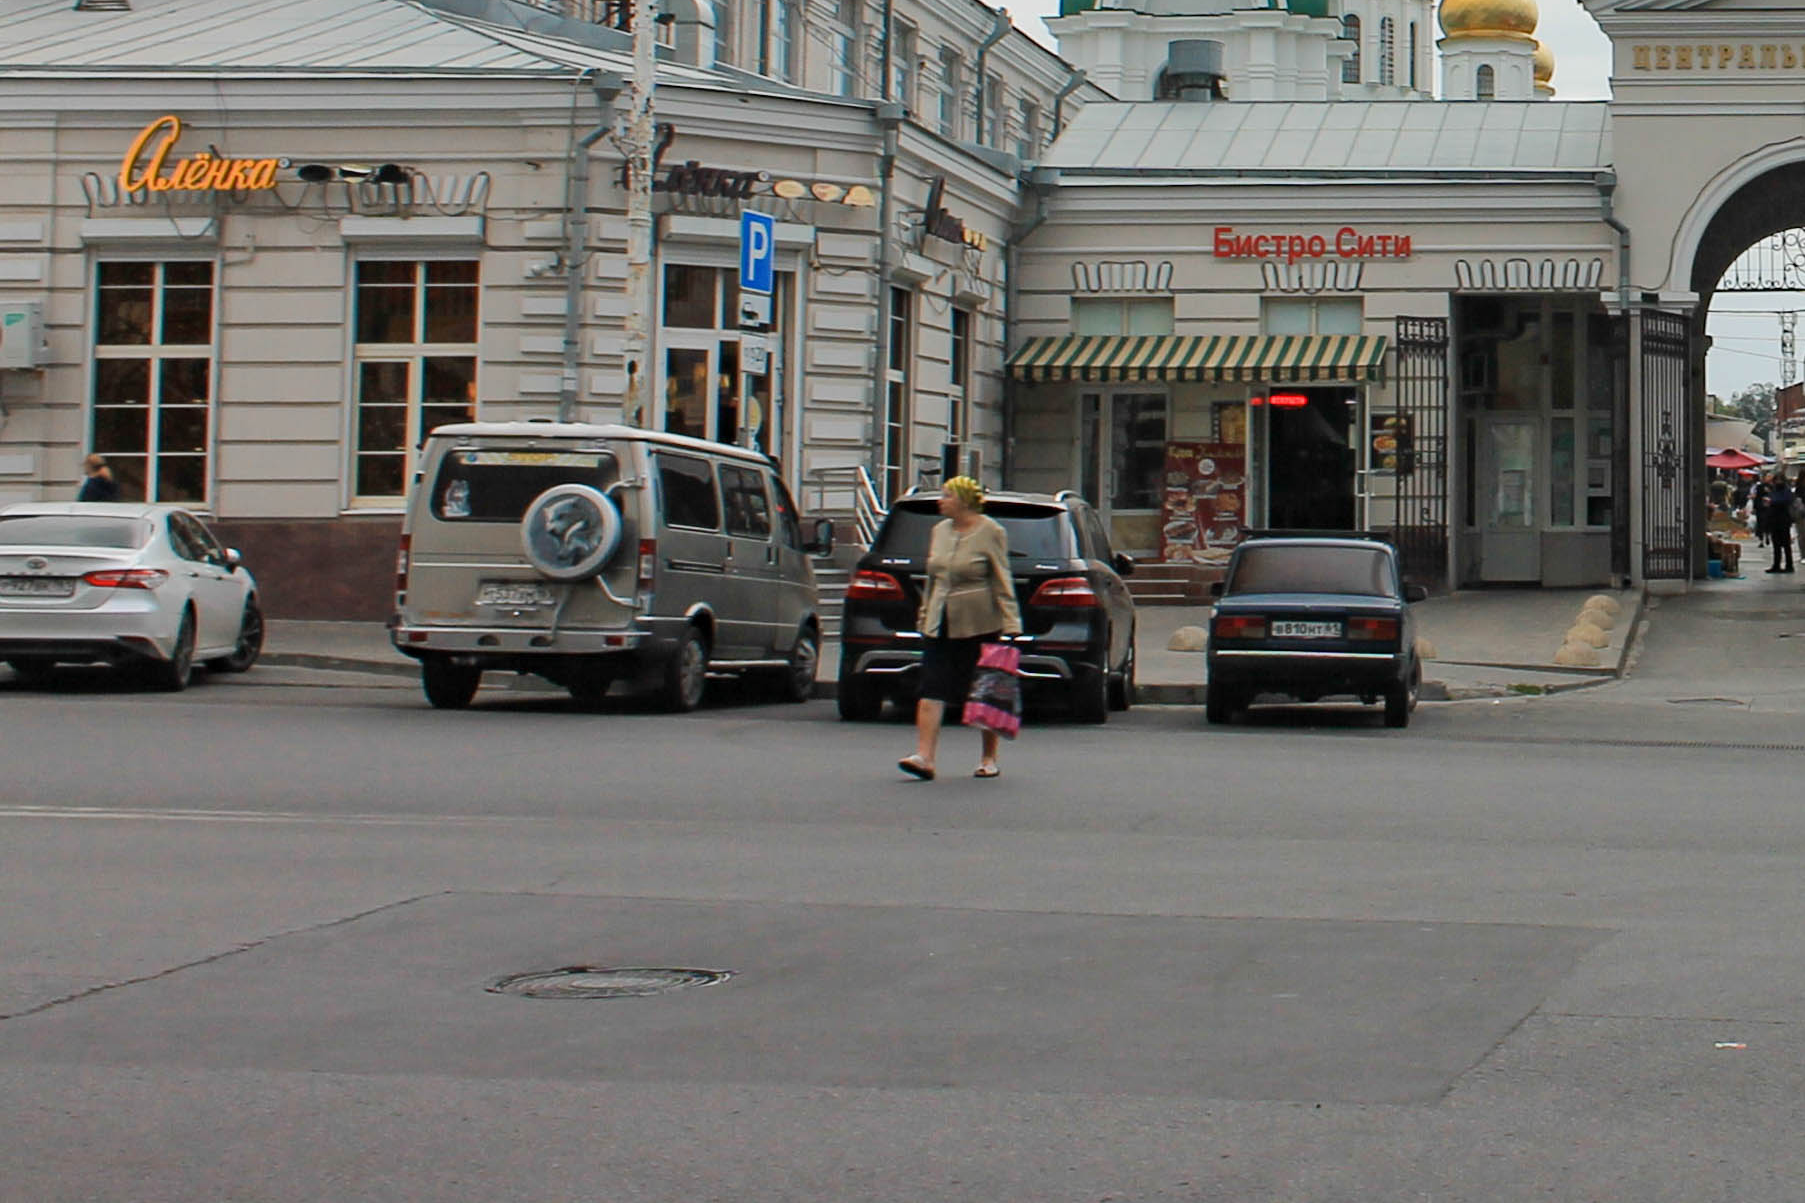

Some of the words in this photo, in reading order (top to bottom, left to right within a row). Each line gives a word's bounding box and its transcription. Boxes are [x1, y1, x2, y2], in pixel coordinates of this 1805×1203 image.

[119, 115, 280, 192] Алёнка
[1213, 226, 1325, 265] Бистро
[1336, 226, 1411, 259] Сити
